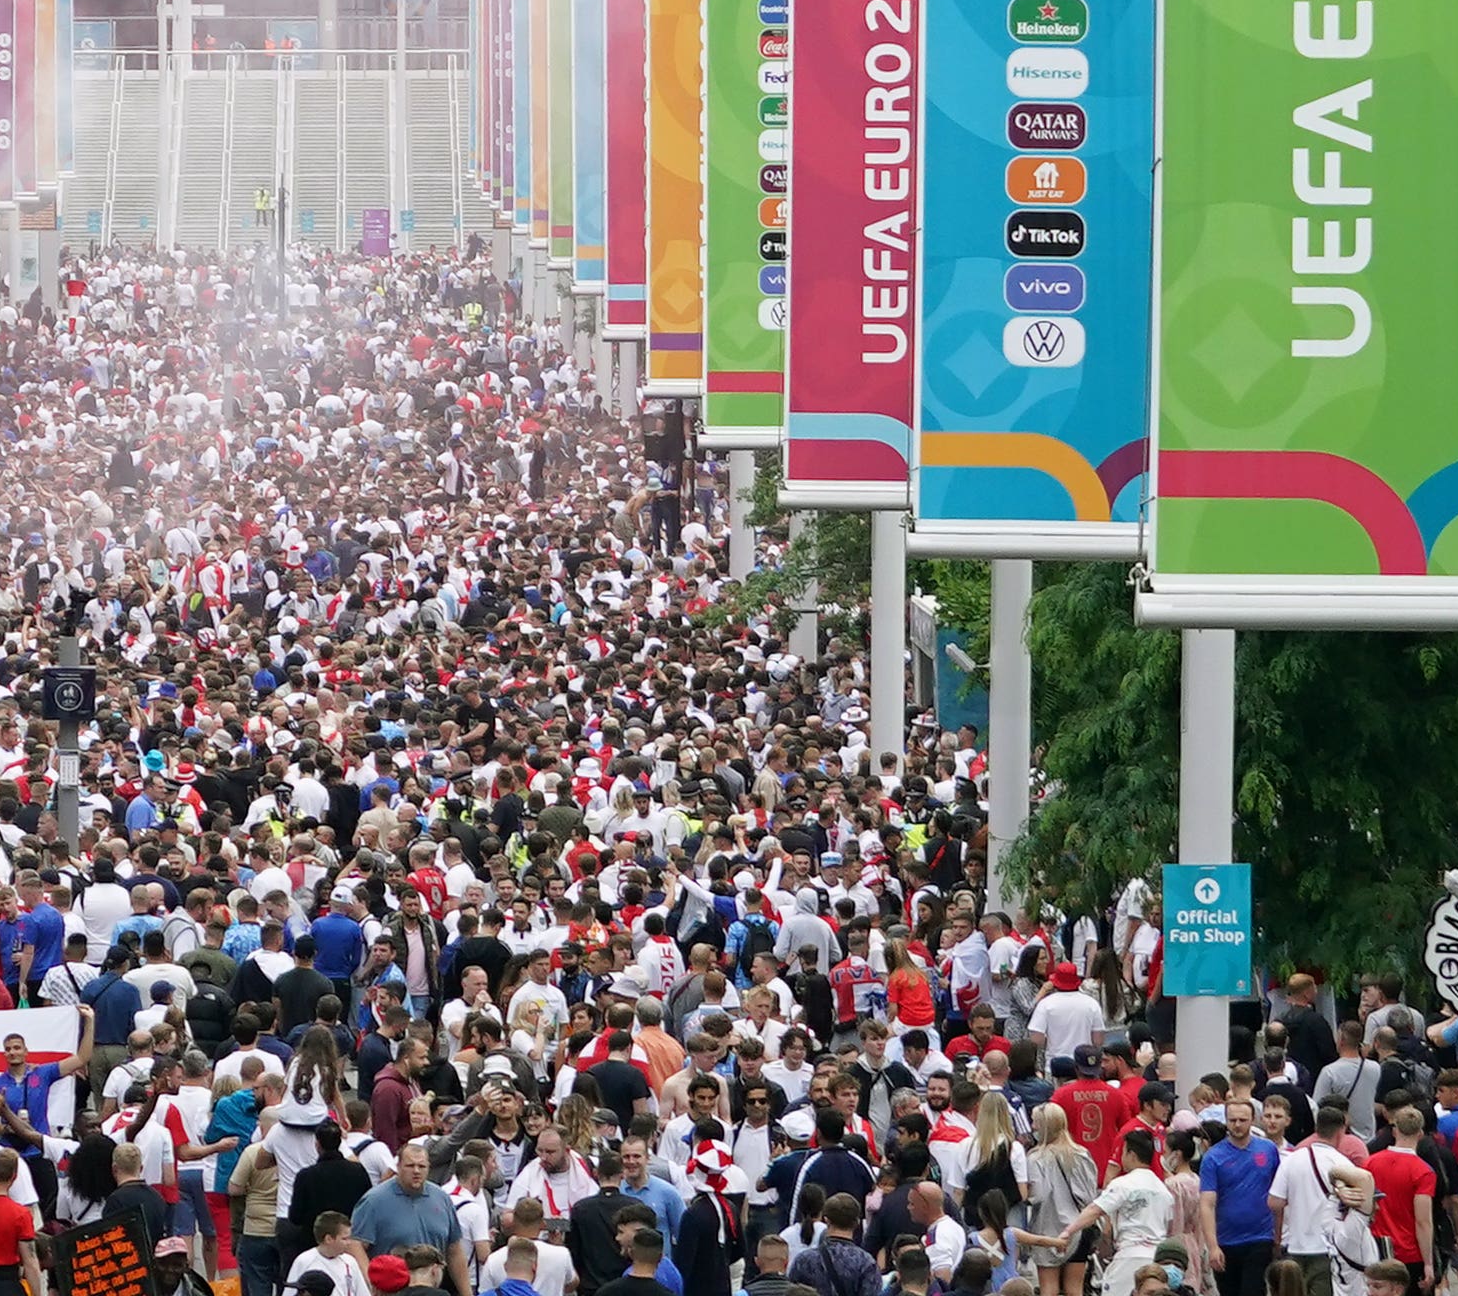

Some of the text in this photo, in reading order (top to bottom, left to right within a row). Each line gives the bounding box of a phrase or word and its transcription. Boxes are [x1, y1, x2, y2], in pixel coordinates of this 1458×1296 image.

[1016, 22, 1079, 36] Heineken
[1013, 66, 1082, 79] Hisense
[862, 43, 912, 201] EURO
[1015, 113, 1078, 132] QATAR
[1030, 129, 1079, 141] AIRWAYS
[1292, 77, 1374, 359] UEFA
[1029, 228, 1080, 244] TikTok
[861, 210, 910, 364] UEFA
[1019, 279, 1071, 294] vivo
[1177, 910, 1238, 924] Official
[1170, 928, 1245, 946] Fan Shop
[1081, 1103, 1103, 1142] 9
[95, 1247, 112, 1261] the
[73, 1271, 91, 1285] the
[120, 1250, 140, 1268] and
